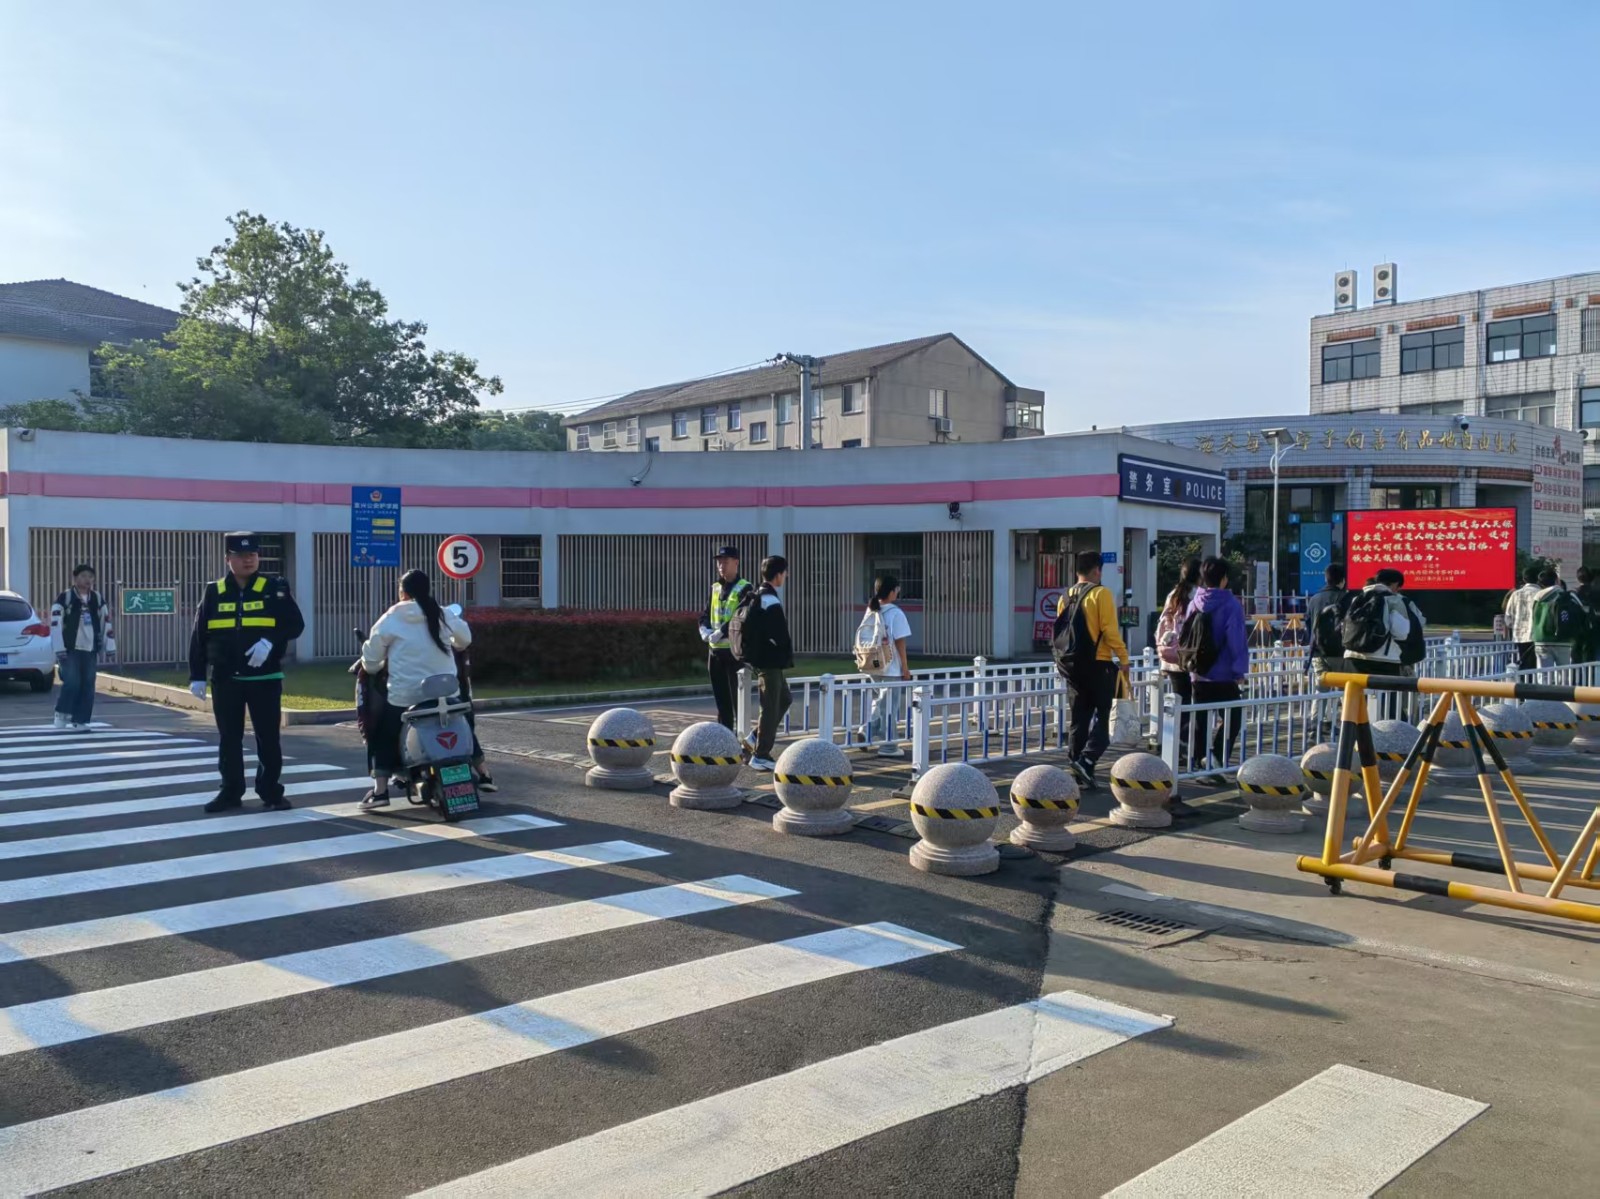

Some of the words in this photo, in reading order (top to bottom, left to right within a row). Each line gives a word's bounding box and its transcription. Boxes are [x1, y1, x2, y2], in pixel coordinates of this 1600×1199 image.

[1129, 470, 1171, 495] 警务室
[1185, 481, 1222, 500] POLICE
[453, 546, 469, 569] 5
